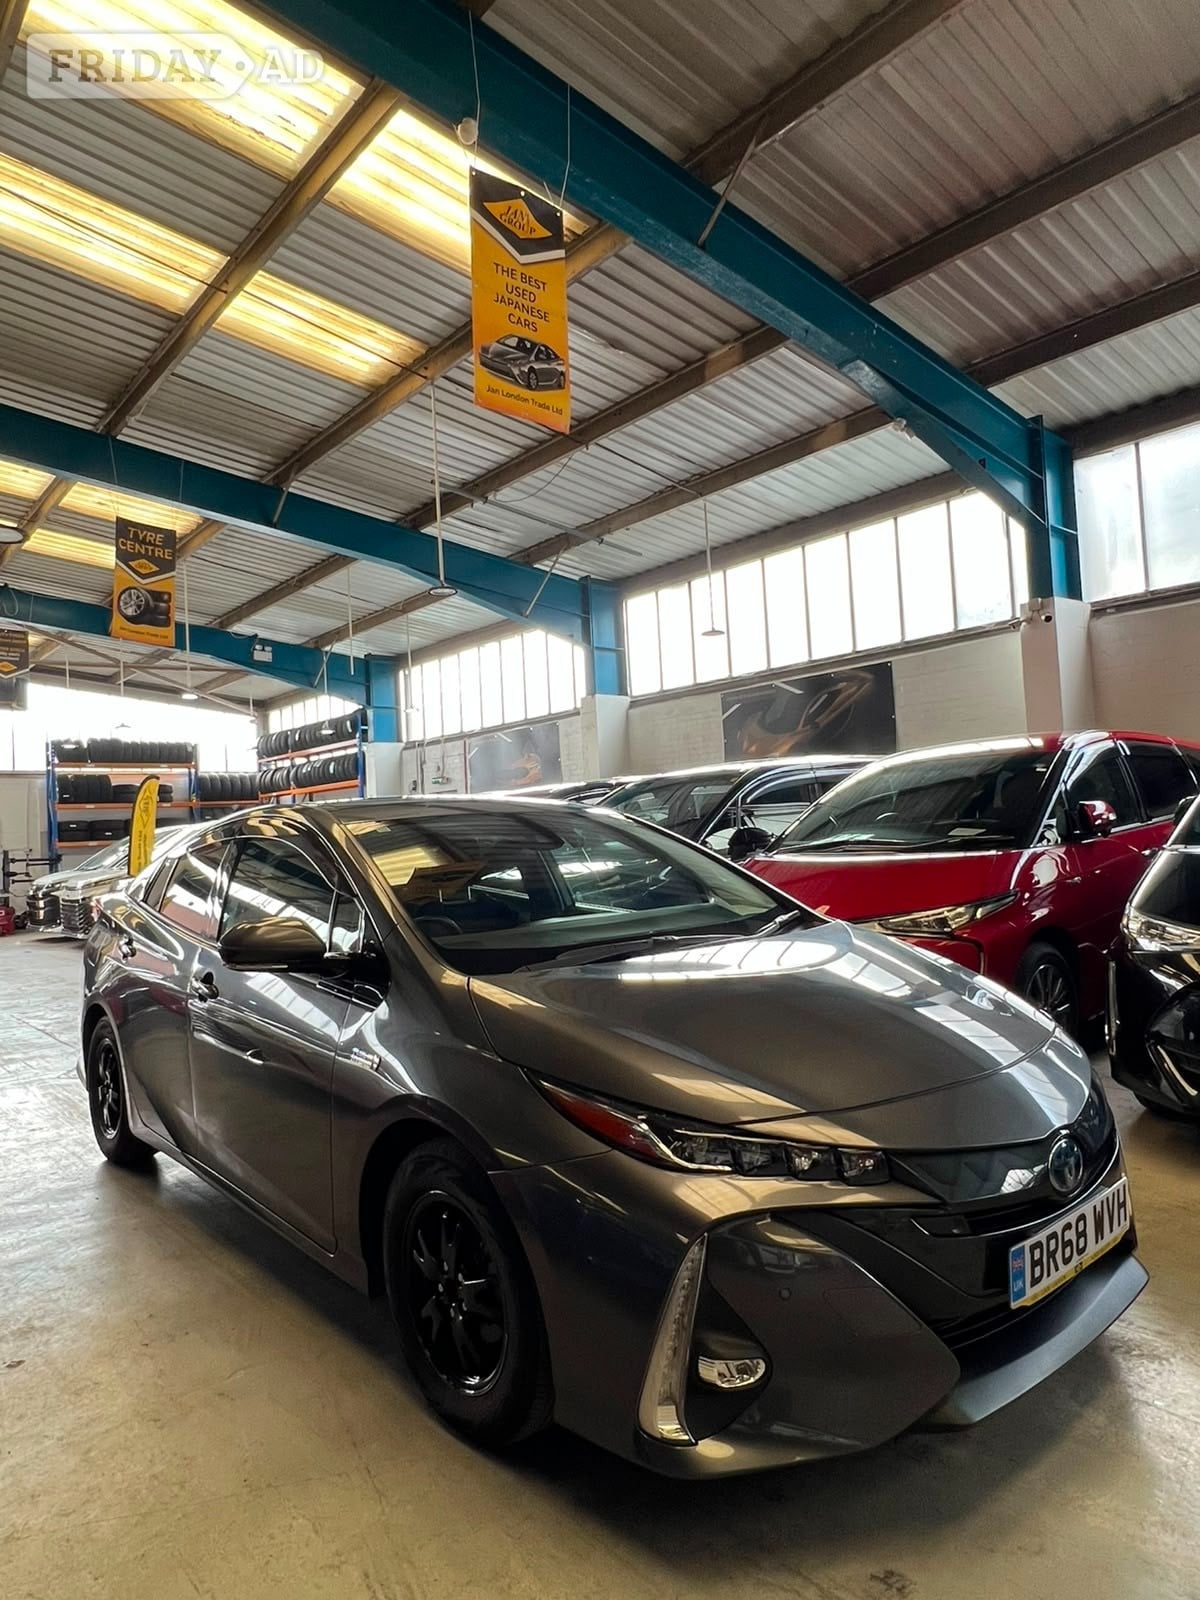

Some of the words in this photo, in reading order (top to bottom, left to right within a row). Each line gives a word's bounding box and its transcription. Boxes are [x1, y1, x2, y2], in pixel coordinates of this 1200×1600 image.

[499, 212, 536, 235] GROUP
[493, 262, 518, 281] THE
[520, 272, 548, 292] BEST
[505, 282, 537, 303] USED
[493, 292, 550, 323] JAPANESE
[508, 312, 538, 332] CARS
[486, 385, 500, 396] Jan
[501, 389, 530, 404] London
[530, 398, 551, 411] Trade
[551, 405, 563, 416] Ltd
[127, 526, 165, 546] TYRE
[118, 538, 173, 560] CENTRE
[1029, 1213, 1088, 1288] BR68
[1093, 1183, 1127, 1245] WVH
